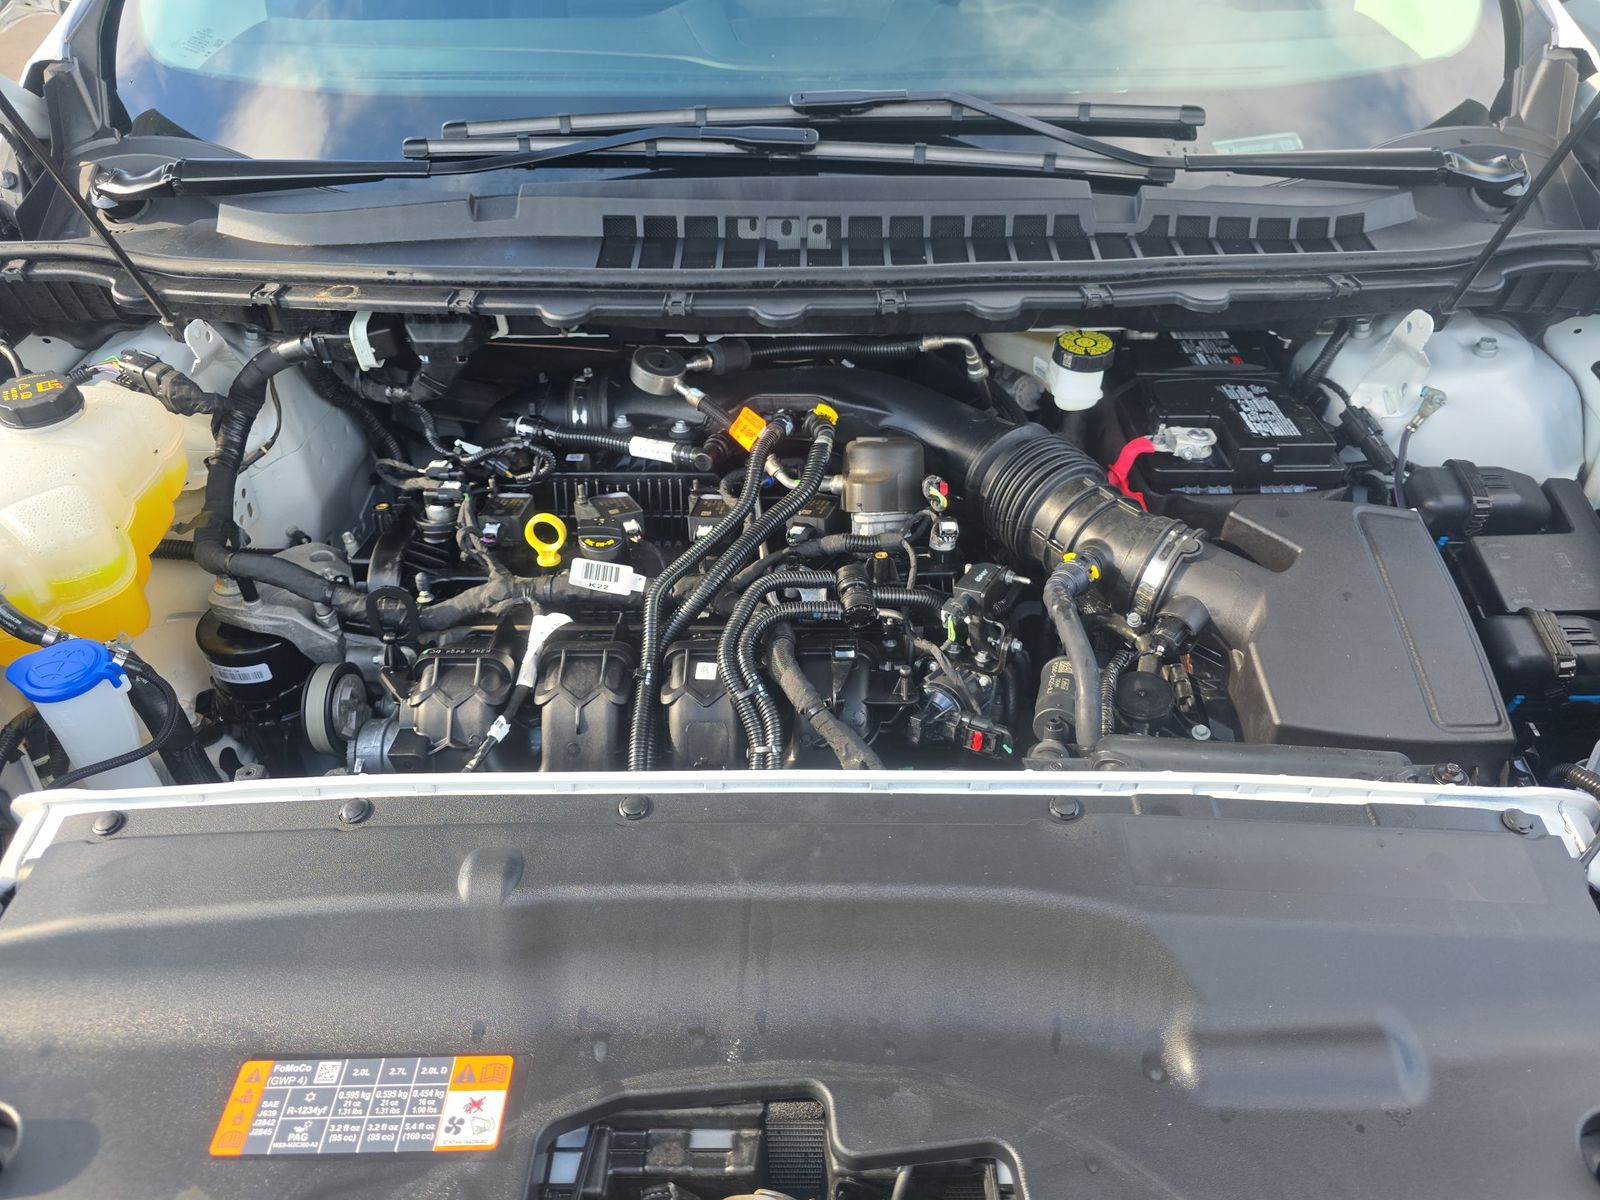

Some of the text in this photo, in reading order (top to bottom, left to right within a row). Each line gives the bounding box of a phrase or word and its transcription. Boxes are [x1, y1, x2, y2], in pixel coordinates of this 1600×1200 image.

[273, 1064, 312, 1072] FoMoCo
[266, 1076, 308, 1087] (GWP 4)
[338, 1091, 371, 1100] 0.595 kg
[376, 1090, 408, 1100] 0.595 kg
[412, 1090, 444, 1099] 0.454 kg
[286, 1106, 328, 1116] R-1234yf
[288, 1133, 308, 1141] PAG
[329, 1134, 356, 1143] (95 cc)
[367, 1134, 381, 1142] (95
